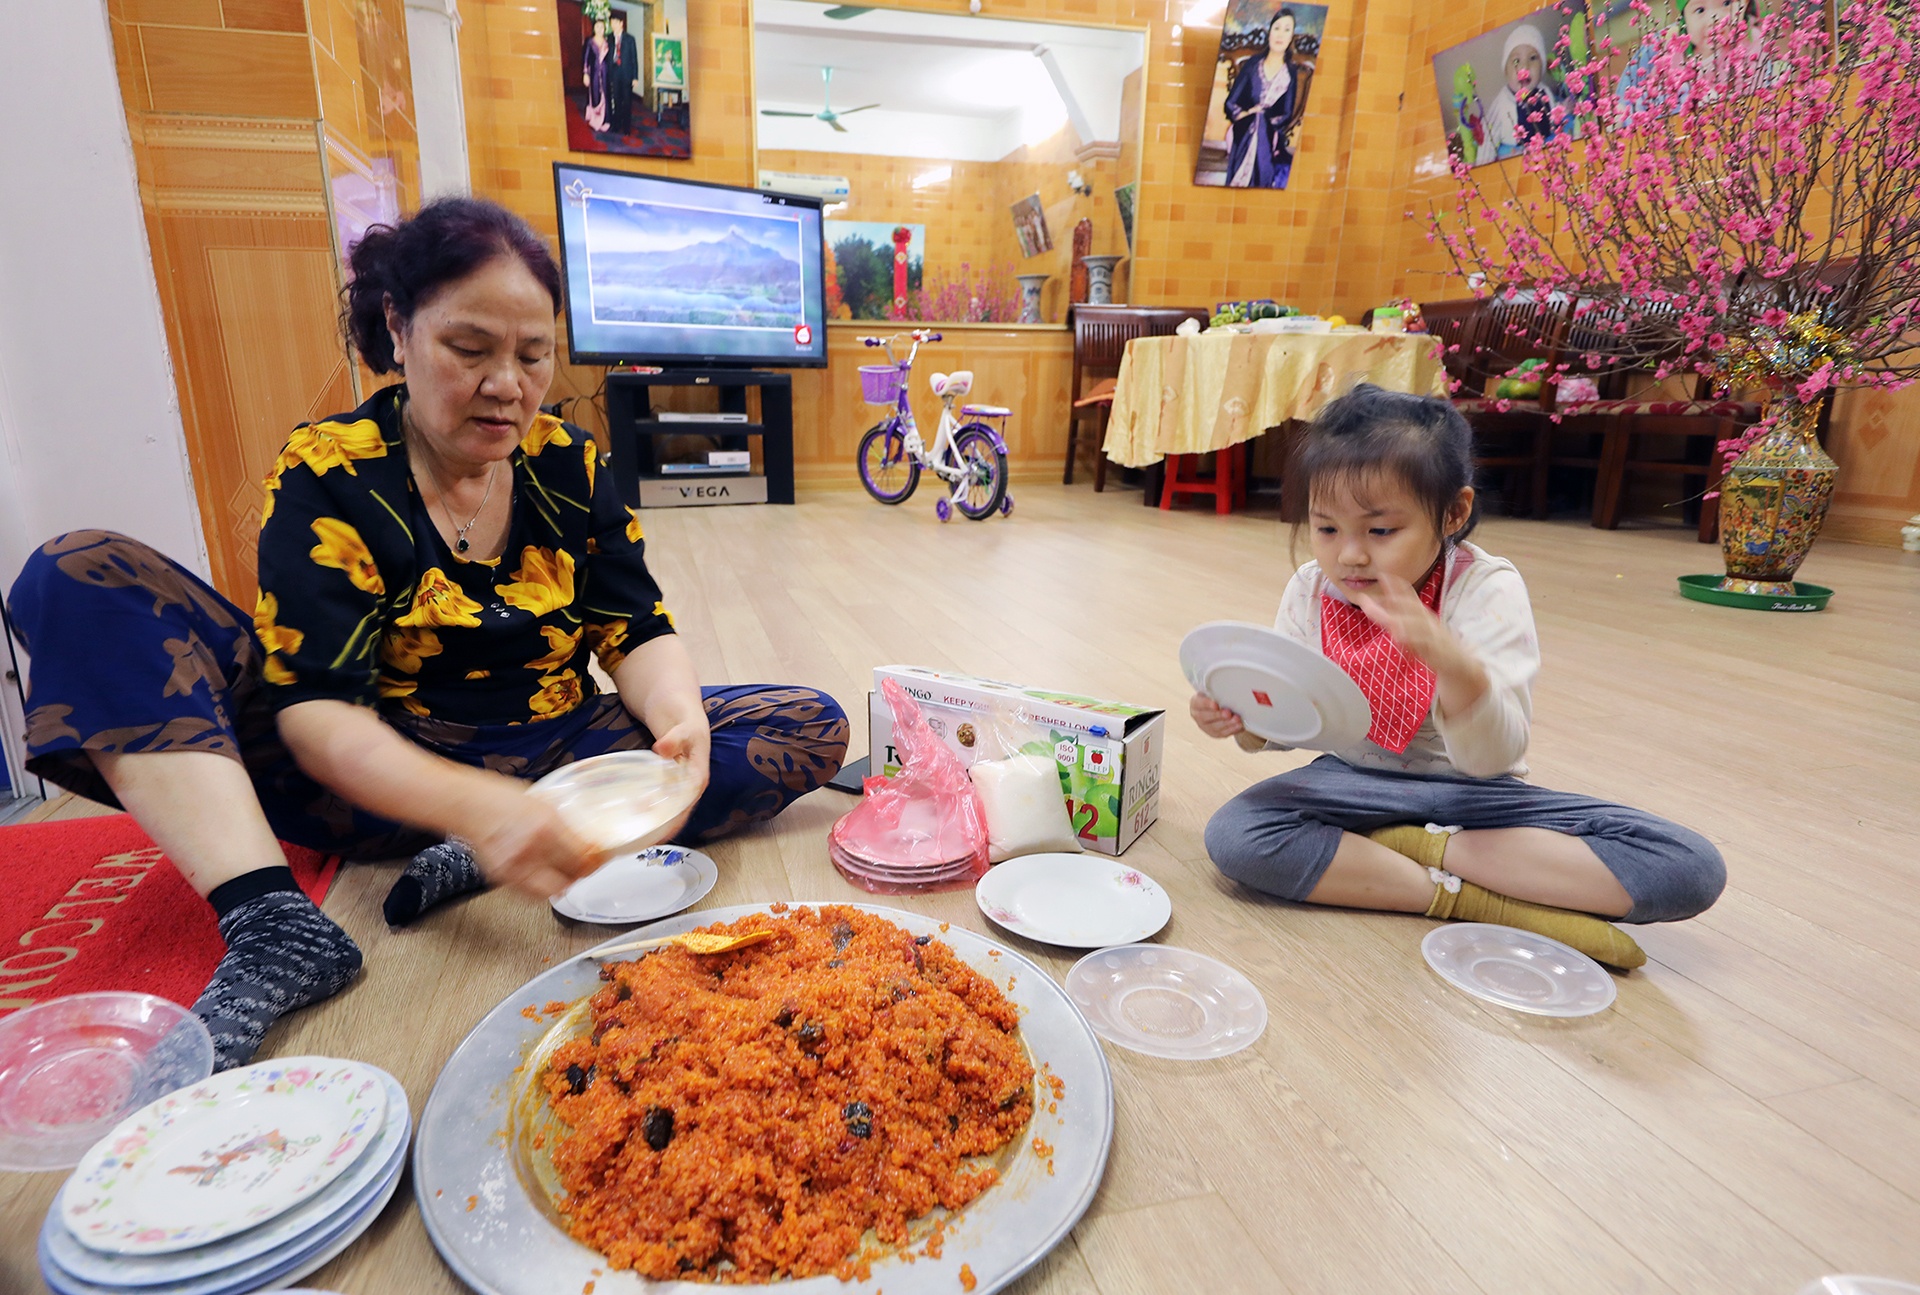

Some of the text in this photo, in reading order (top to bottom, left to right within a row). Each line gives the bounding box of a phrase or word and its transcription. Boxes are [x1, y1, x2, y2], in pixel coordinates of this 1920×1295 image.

[943, 695, 967, 707] KEEP
[1023, 711, 1067, 728] RESHER
[1057, 753, 1075, 763] 9001
[1059, 744, 1074, 753] ISO
[1128, 764, 1159, 807] RINGO
[1134, 803, 1150, 834] 612
